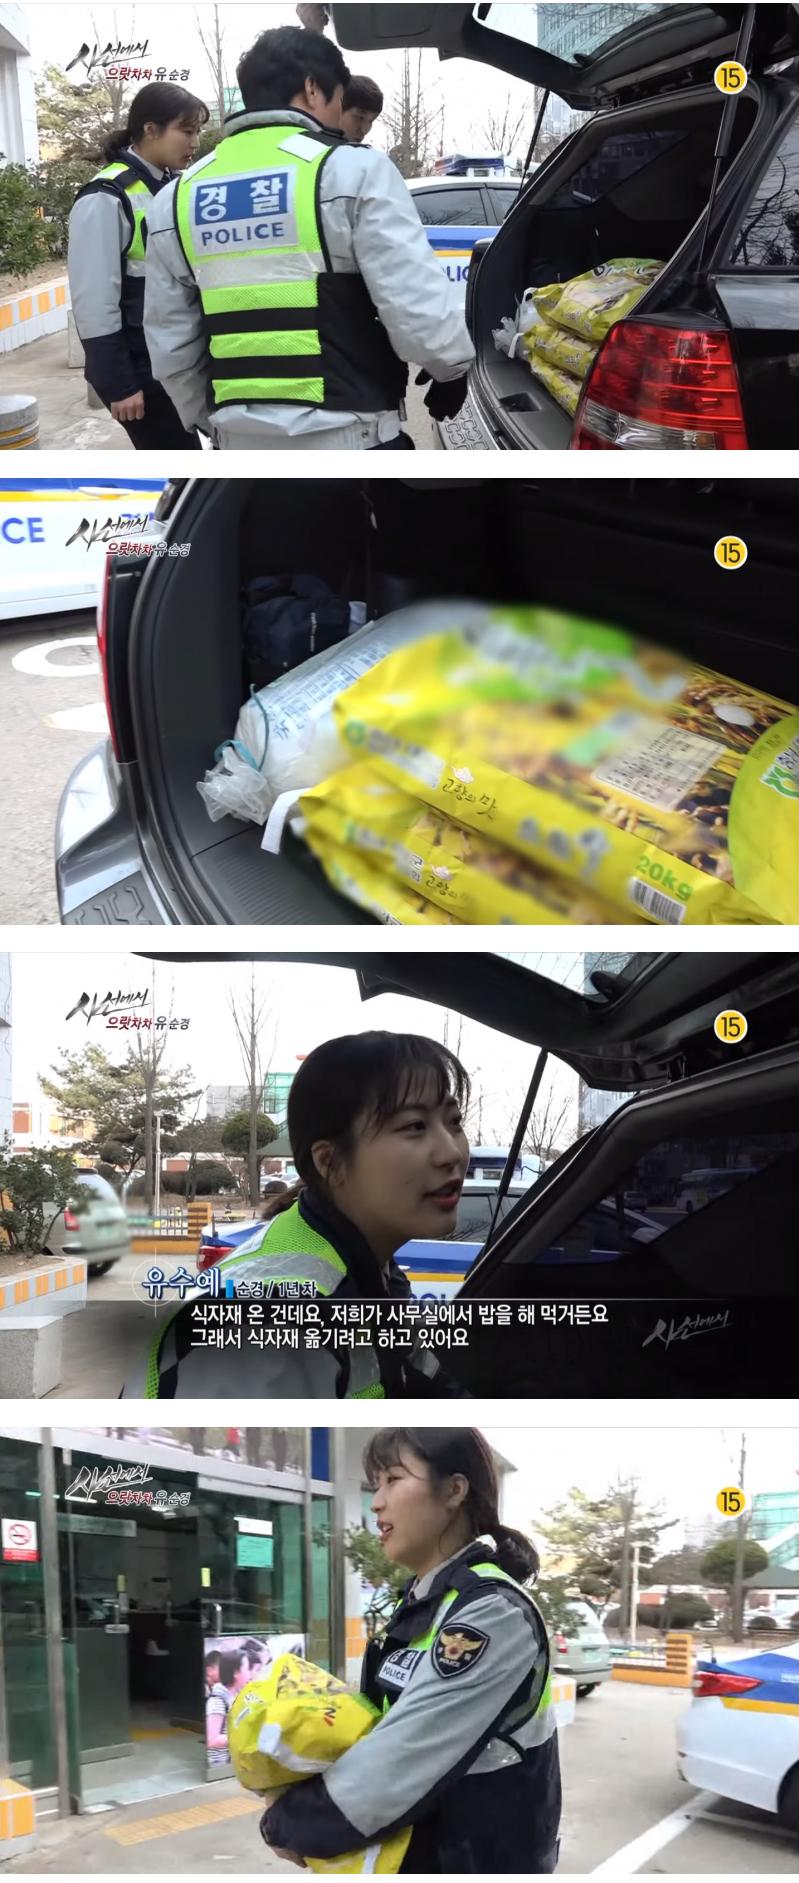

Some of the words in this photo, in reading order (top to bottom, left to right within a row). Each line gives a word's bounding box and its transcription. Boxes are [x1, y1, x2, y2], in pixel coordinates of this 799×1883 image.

[199, 177, 282, 221] 경찰
[201, 222, 285, 246] POLICE
[636, 855, 693, 902] 20kg
